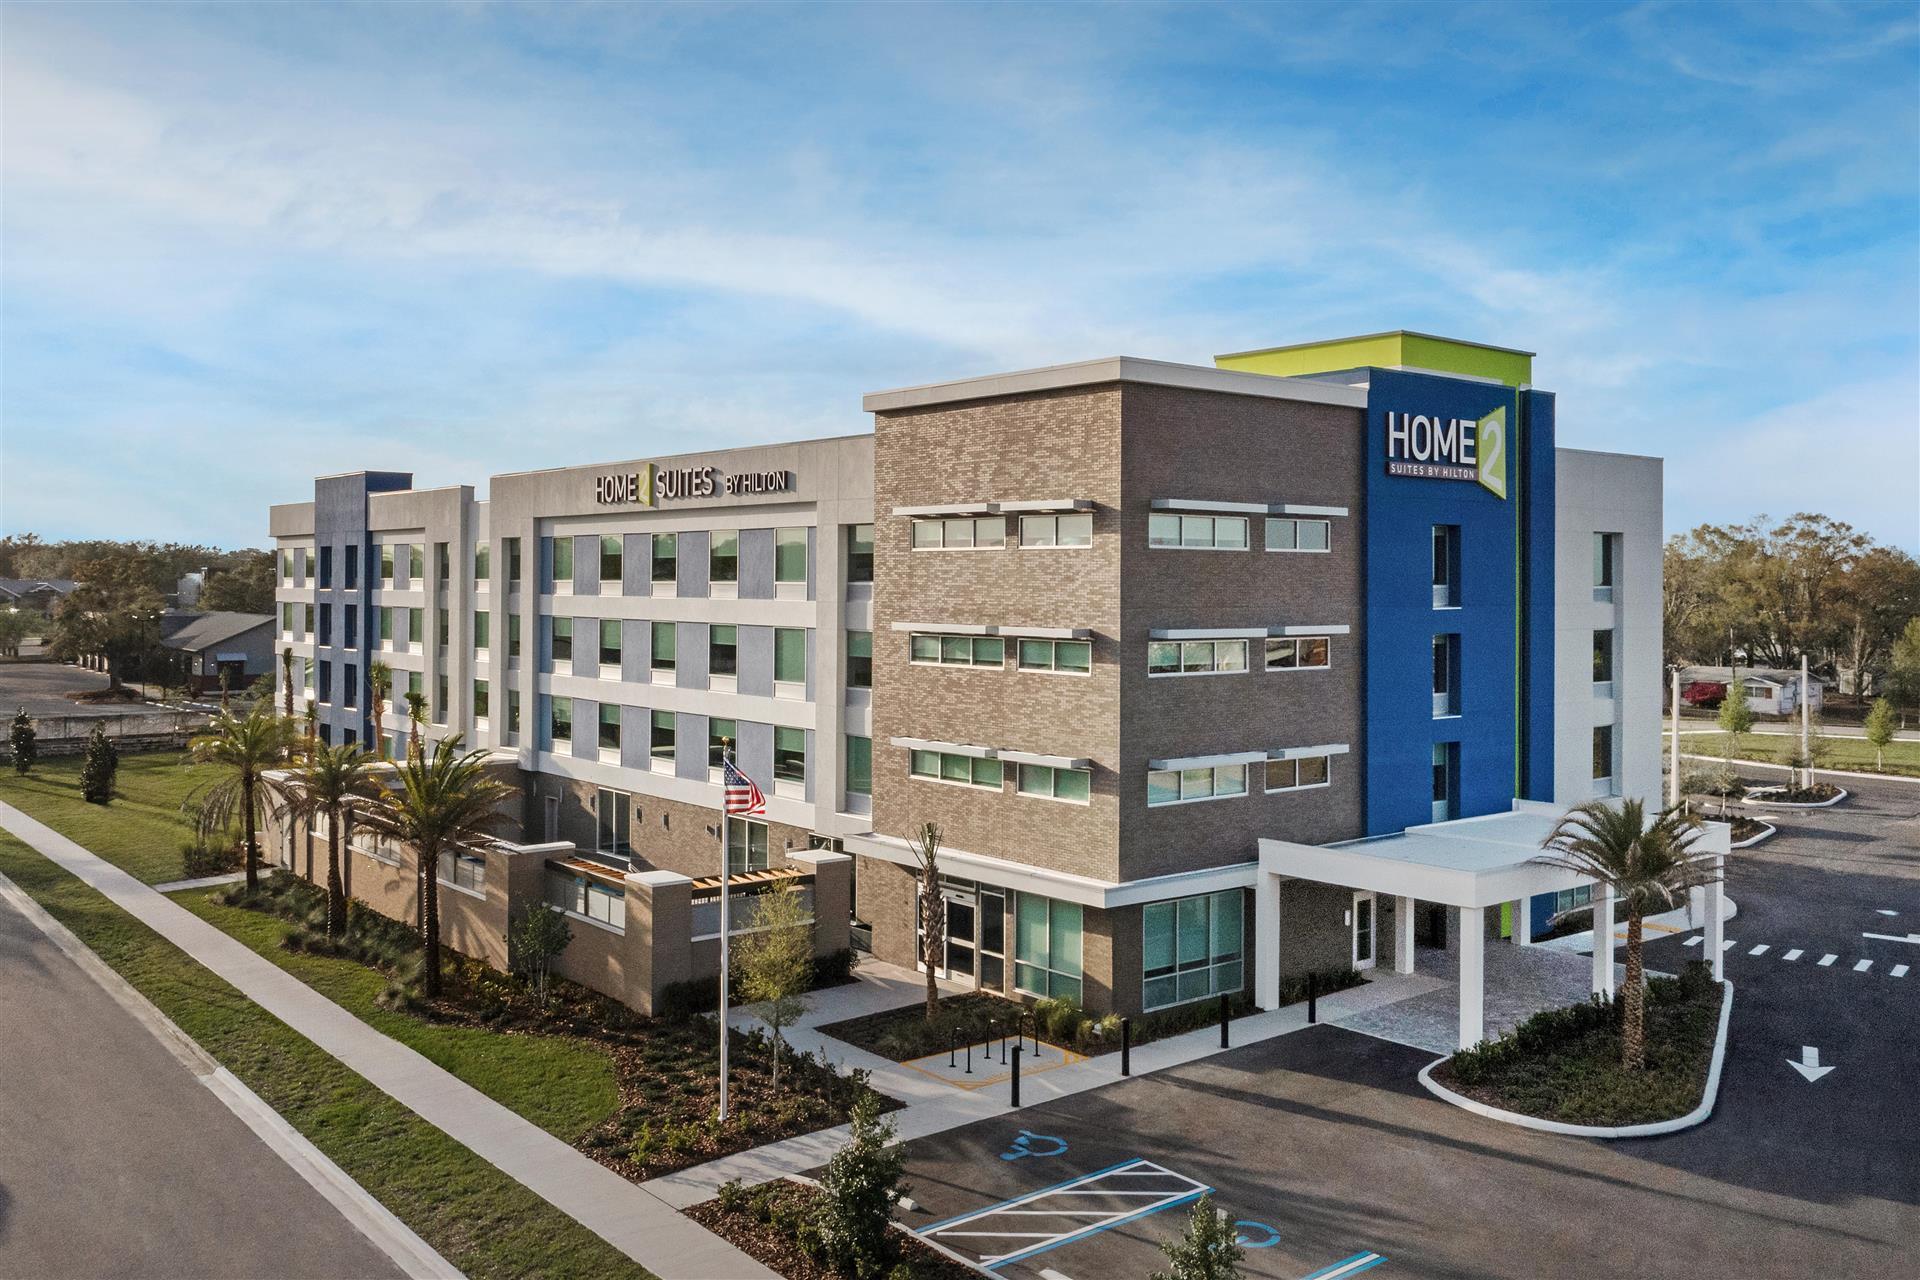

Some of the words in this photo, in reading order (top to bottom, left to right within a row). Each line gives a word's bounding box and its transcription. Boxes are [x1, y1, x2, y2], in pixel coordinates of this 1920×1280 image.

[655, 466, 713, 498] SUITES
[725, 474, 740, 494] BY
[742, 470, 785, 492] HILTON
[1391, 463, 1424, 475] SUITES
[1427, 466, 1439, 476] BY
[1442, 467, 1474, 479] HILTON
